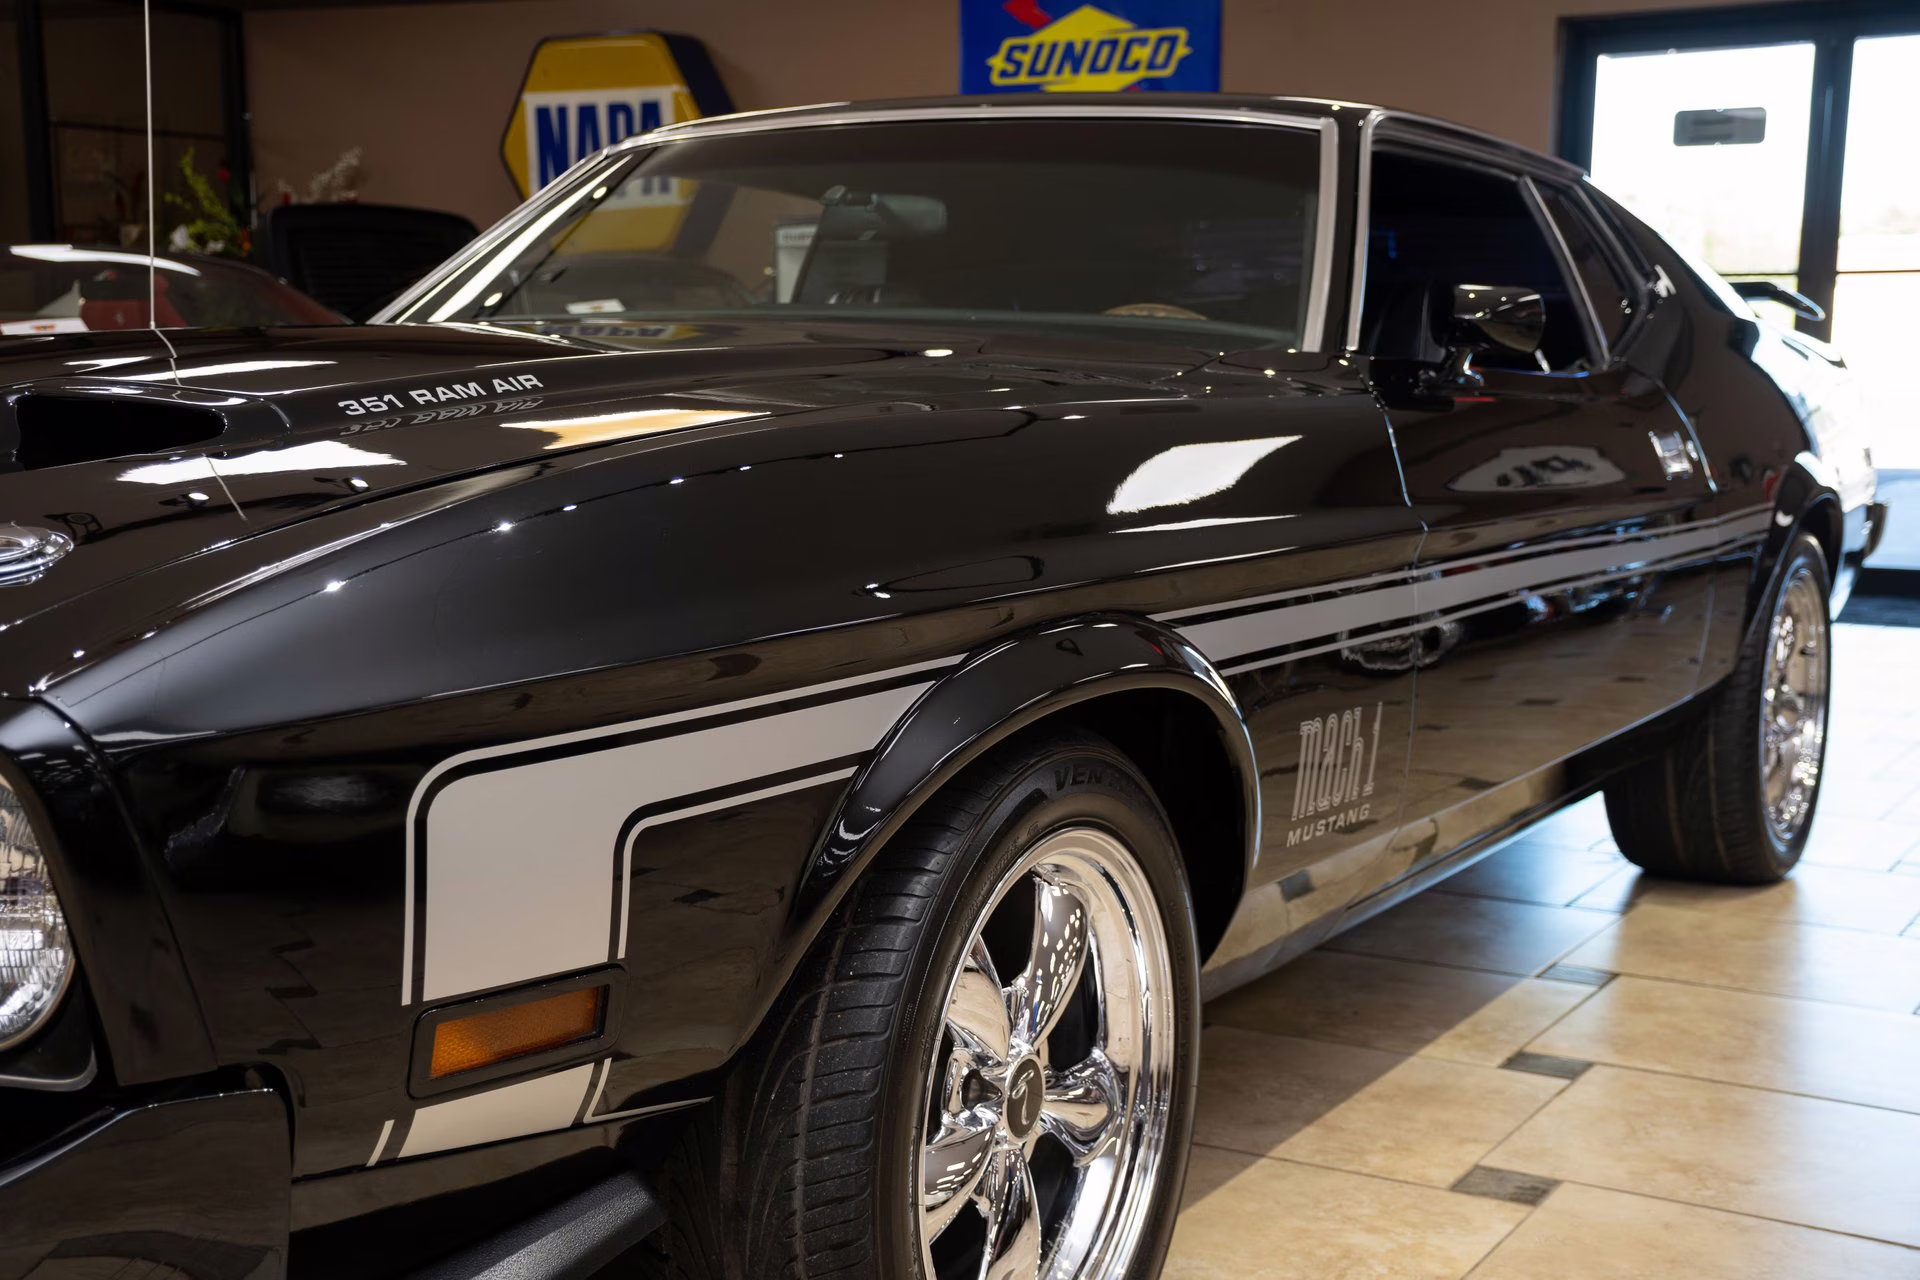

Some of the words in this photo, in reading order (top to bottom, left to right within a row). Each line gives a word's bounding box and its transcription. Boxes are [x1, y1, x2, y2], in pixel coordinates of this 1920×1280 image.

[996, 35, 1179, 79] SUNOCO
[338, 394, 404, 416] 351
[408, 382, 487, 405] RAM
[492, 374, 544, 394] AIR
[1286, 803, 1370, 848] MUSTANG
